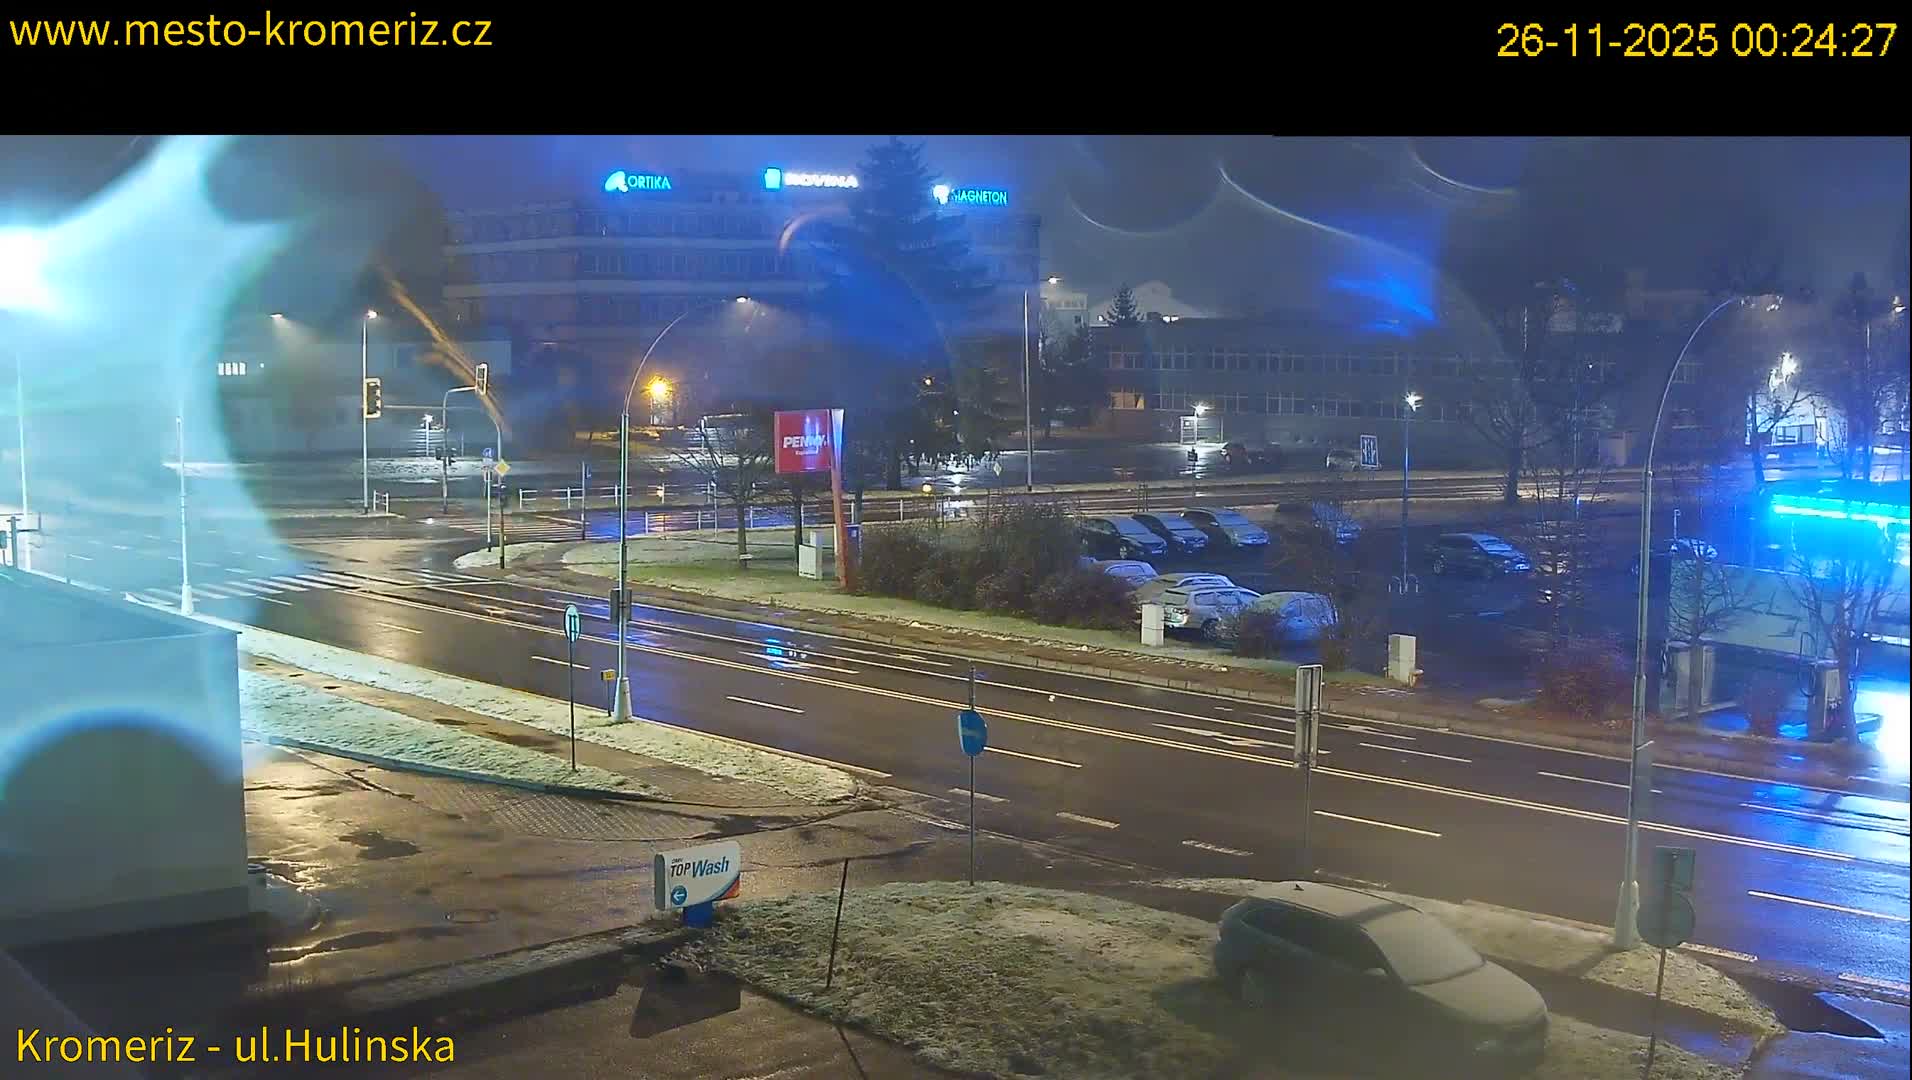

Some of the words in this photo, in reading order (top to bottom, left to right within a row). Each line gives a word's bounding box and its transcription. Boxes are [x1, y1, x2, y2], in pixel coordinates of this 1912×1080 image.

[627, 175, 672, 190] ORTIKA
[670, 862, 691, 878] TOP
[692, 856, 730, 878] Wash
